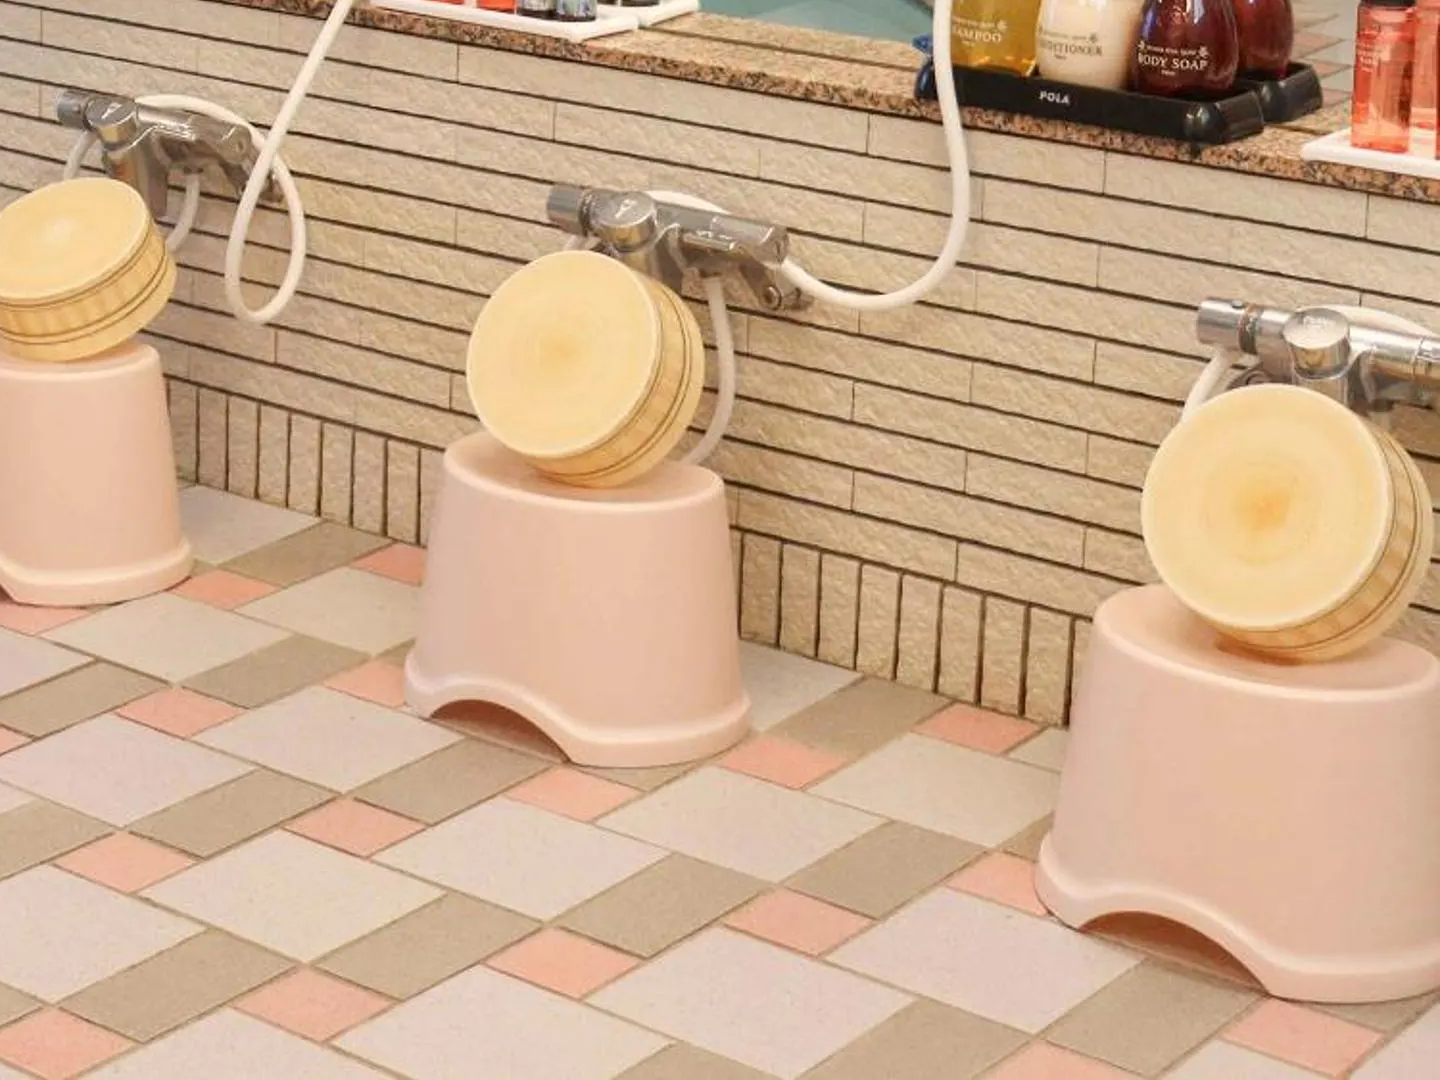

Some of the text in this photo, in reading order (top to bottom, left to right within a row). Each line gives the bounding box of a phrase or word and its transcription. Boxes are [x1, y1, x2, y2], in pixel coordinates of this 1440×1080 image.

[1138, 52, 1208, 71] BODY SOAP
[1038, 90, 1071, 106] POLA
